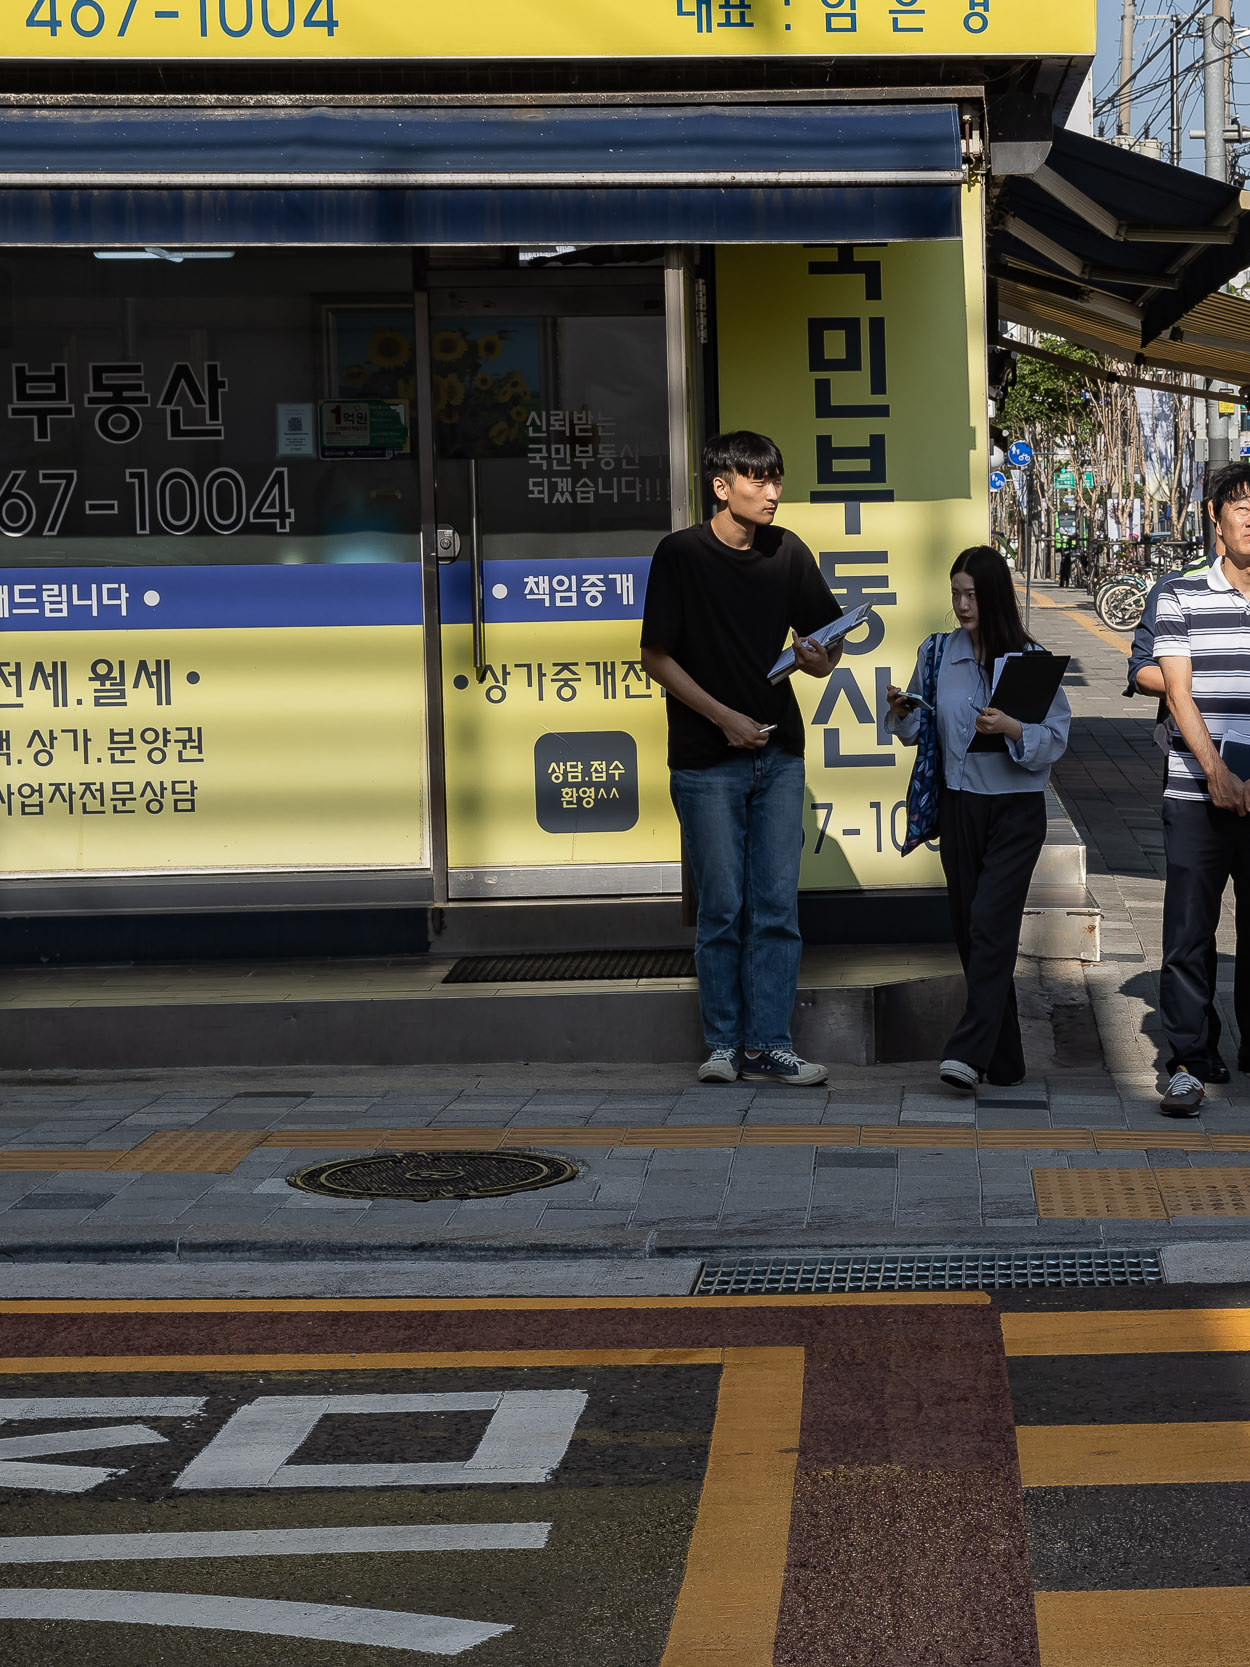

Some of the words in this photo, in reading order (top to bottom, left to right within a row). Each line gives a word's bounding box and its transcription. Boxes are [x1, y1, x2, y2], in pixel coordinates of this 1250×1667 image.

[26, 0, 339, 37] 467-1004
[677, 0, 754, 33] 대표
[8, 361, 228, 444] 부동산
[526, 410, 617, 437] 신뢰받는
[0, 467, 295, 538] 67-1004
[523, 573, 635, 608] 책임중개
[0, 658, 172, 708] 전세.월세
[477, 660, 667, 704] 상가중개전
[547, 760, 626, 783] 상담.접수
[560, 787, 620, 809] 환영^^
